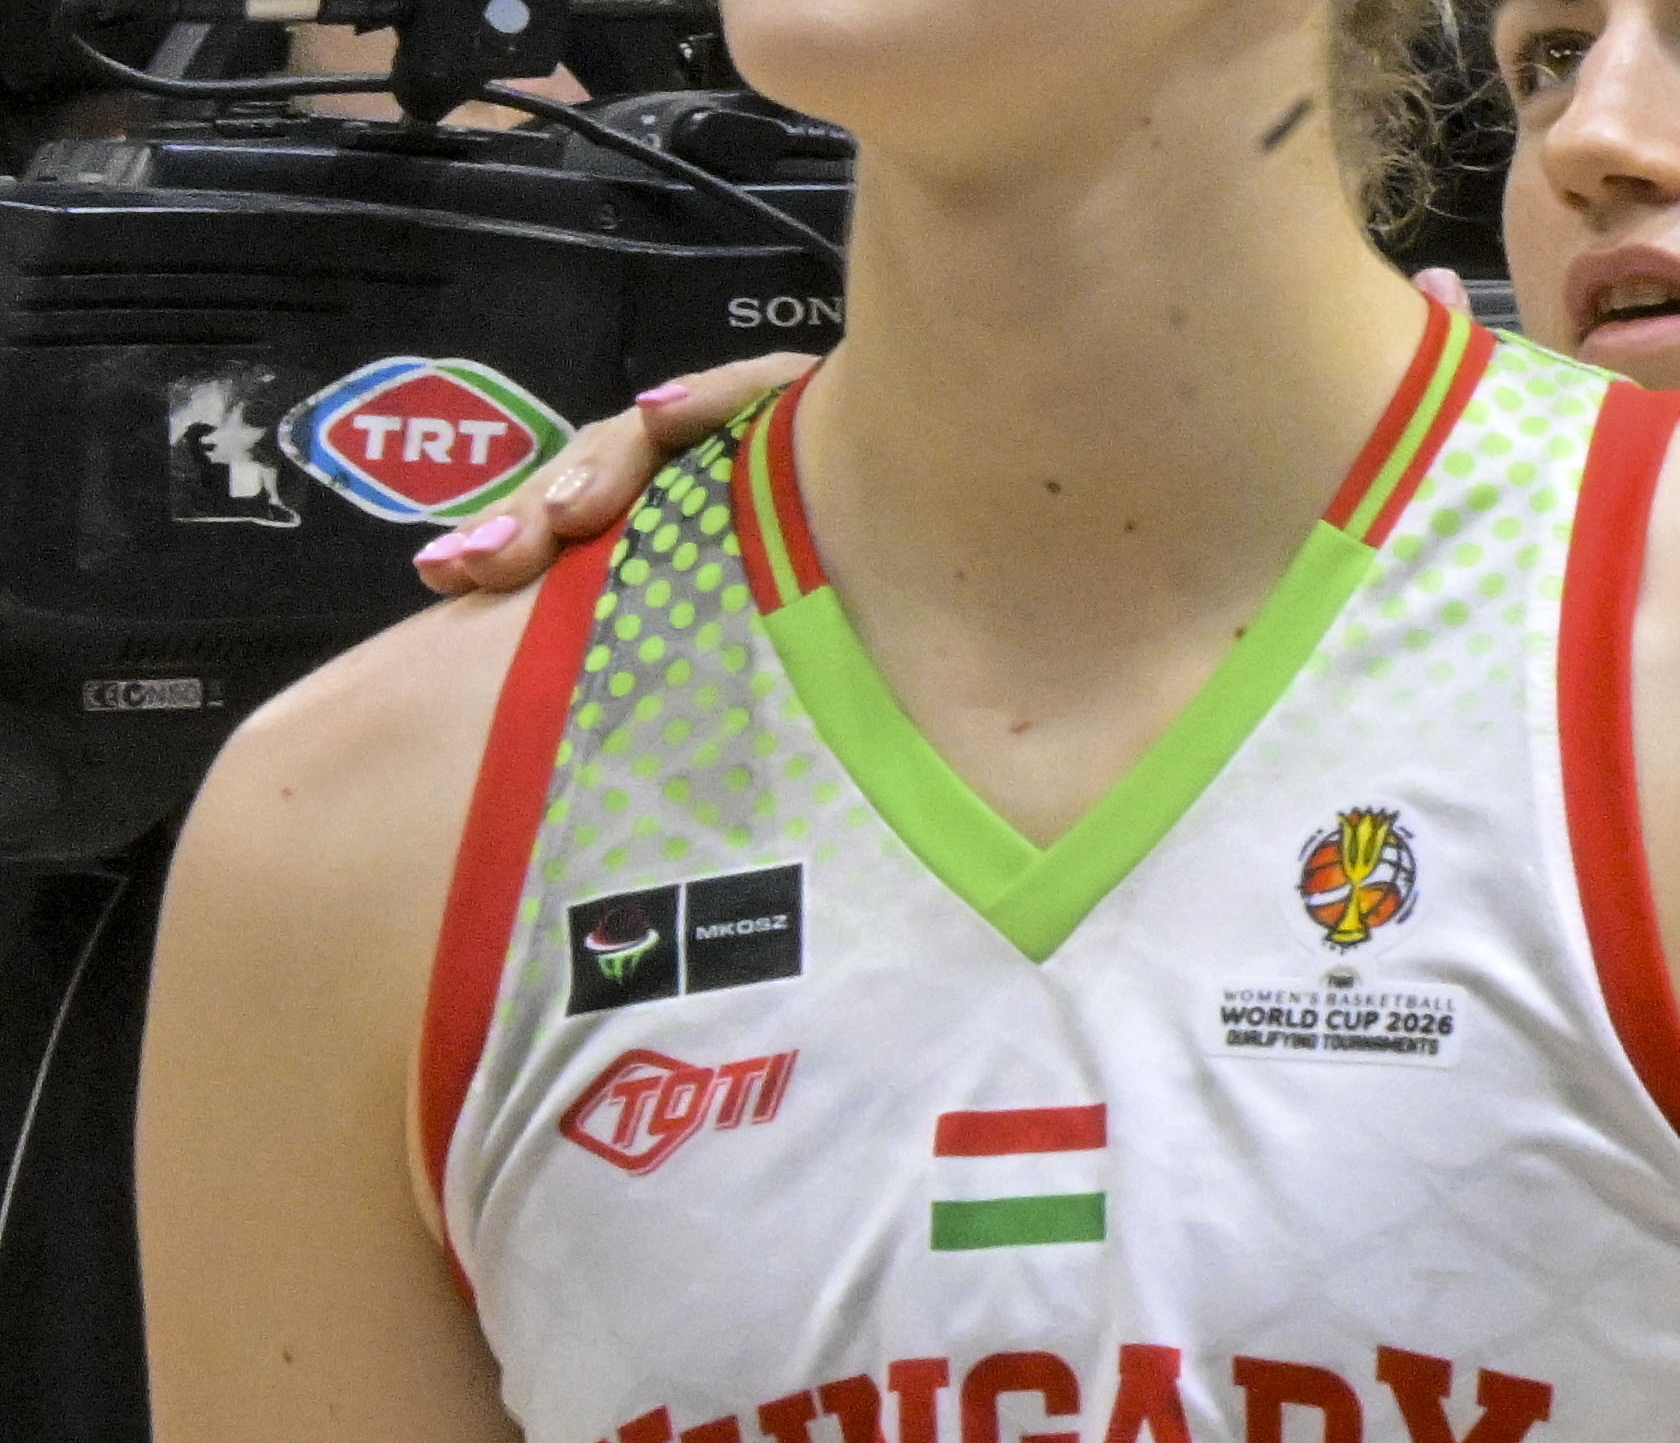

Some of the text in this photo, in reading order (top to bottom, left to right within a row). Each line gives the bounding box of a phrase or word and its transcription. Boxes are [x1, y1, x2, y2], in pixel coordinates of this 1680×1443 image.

[353, 414, 508, 466] TRT
[695, 914, 788, 940] MKOSZ
[1326, 992, 1456, 1013] BASKETBALL
[1219, 1005, 1454, 1036] WORLD CUP 2026
